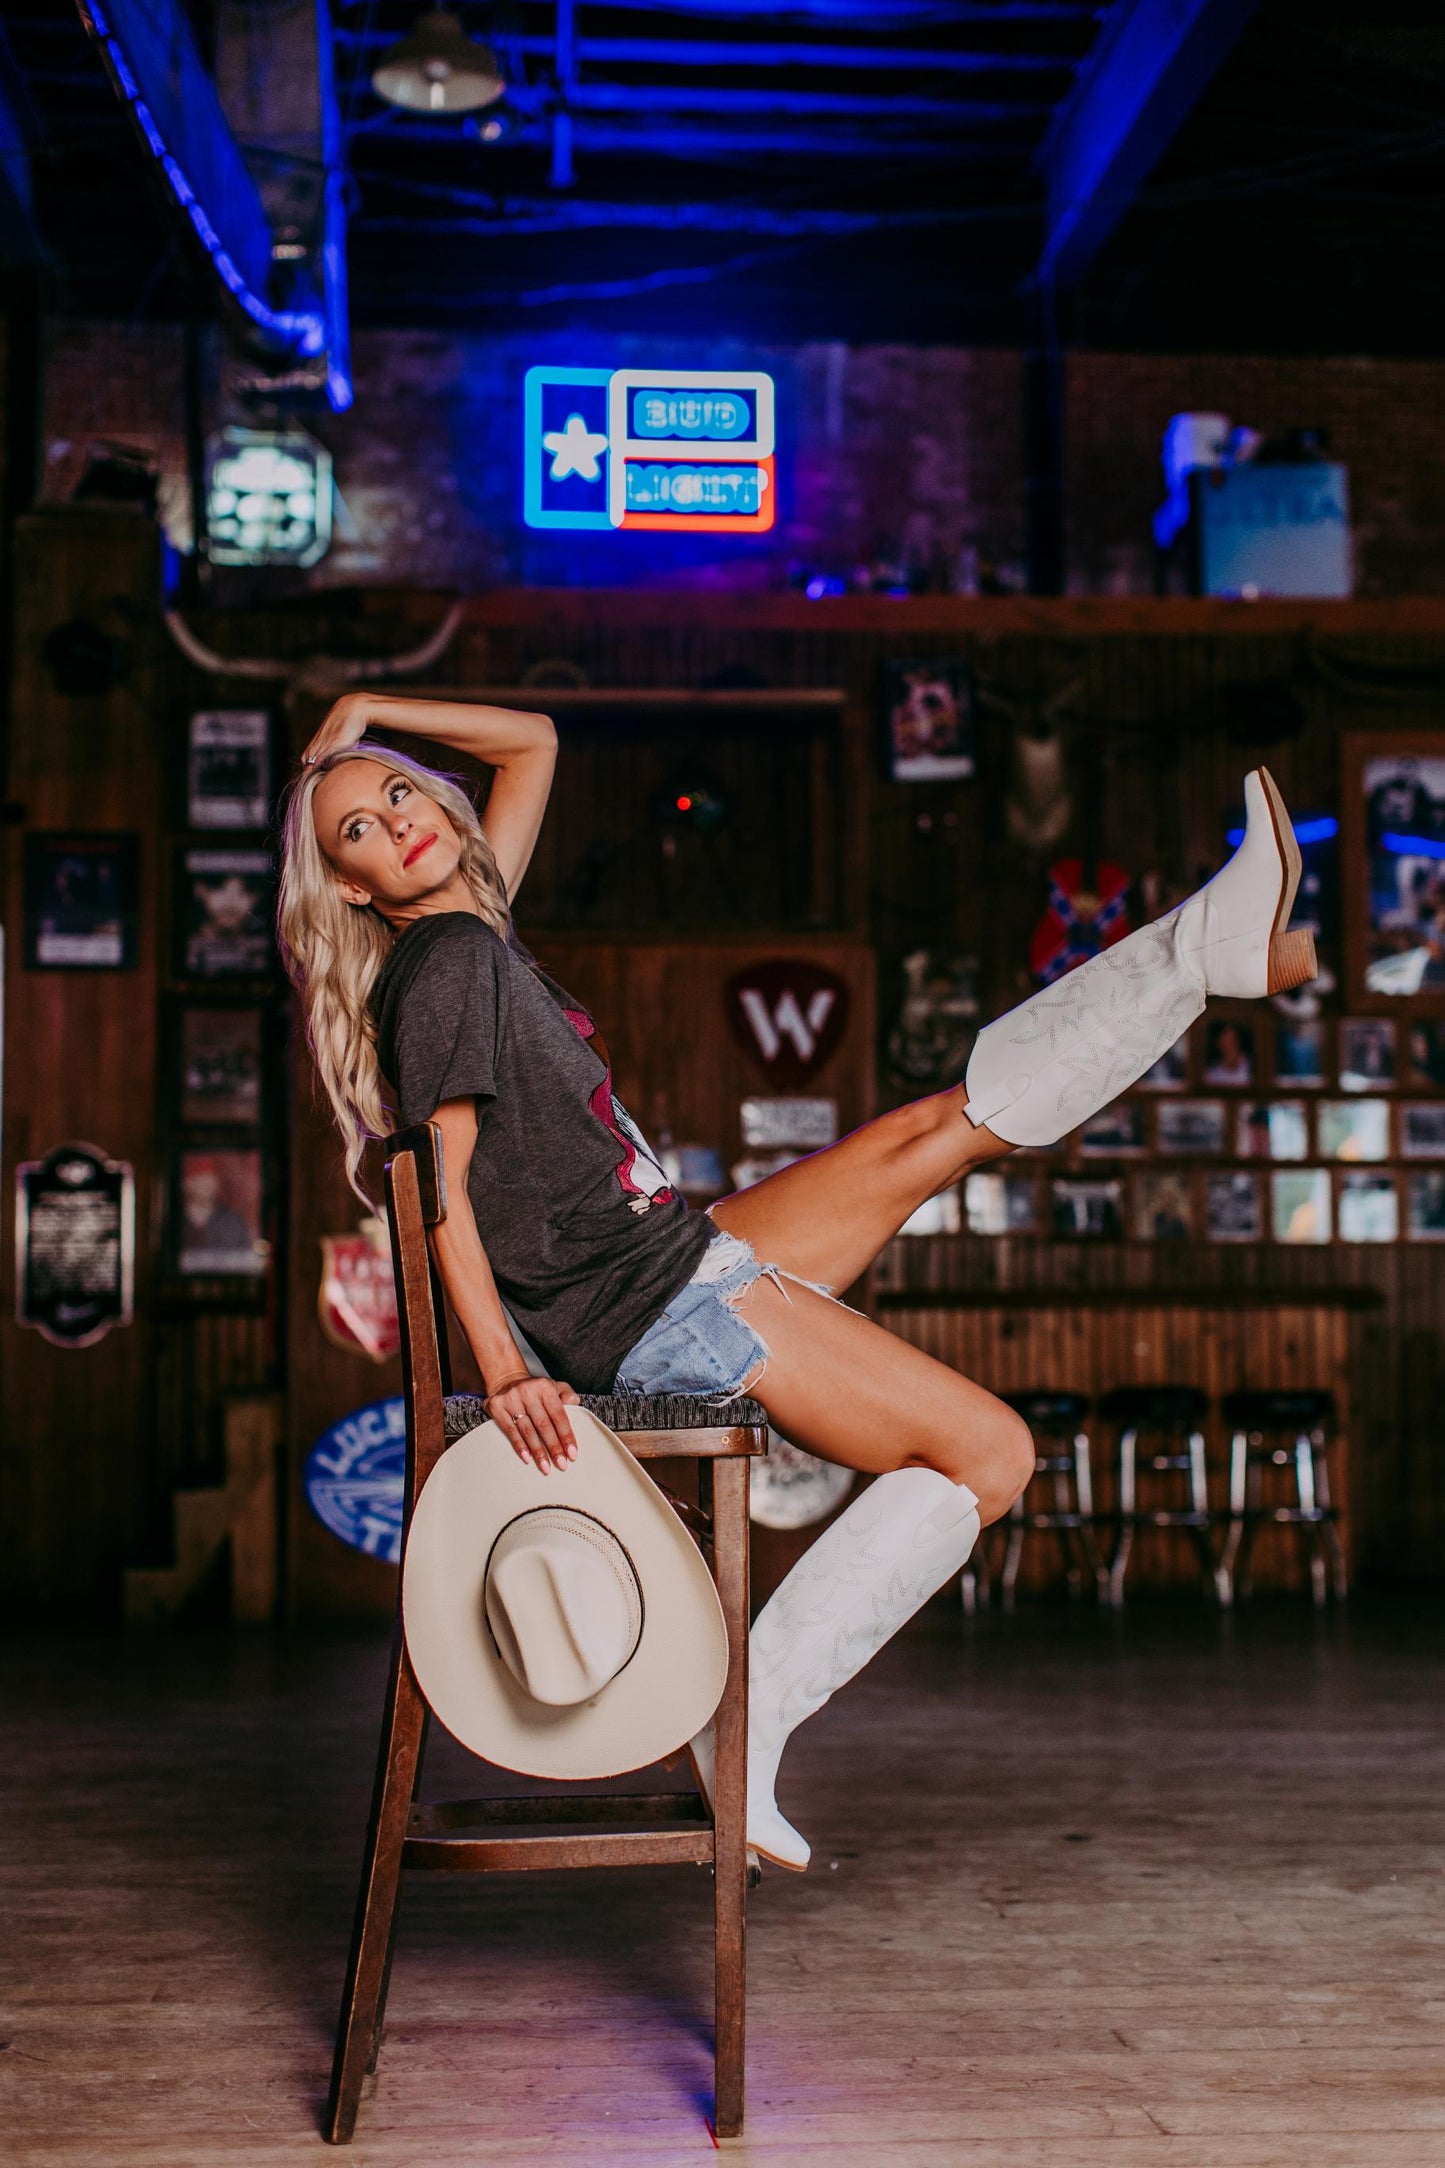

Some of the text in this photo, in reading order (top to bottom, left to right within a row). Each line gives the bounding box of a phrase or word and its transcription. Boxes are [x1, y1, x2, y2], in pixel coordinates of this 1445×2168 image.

[636, 392, 748, 437] BUD
[626, 466, 767, 511] LIGHT
[738, 988, 837, 1063] W
